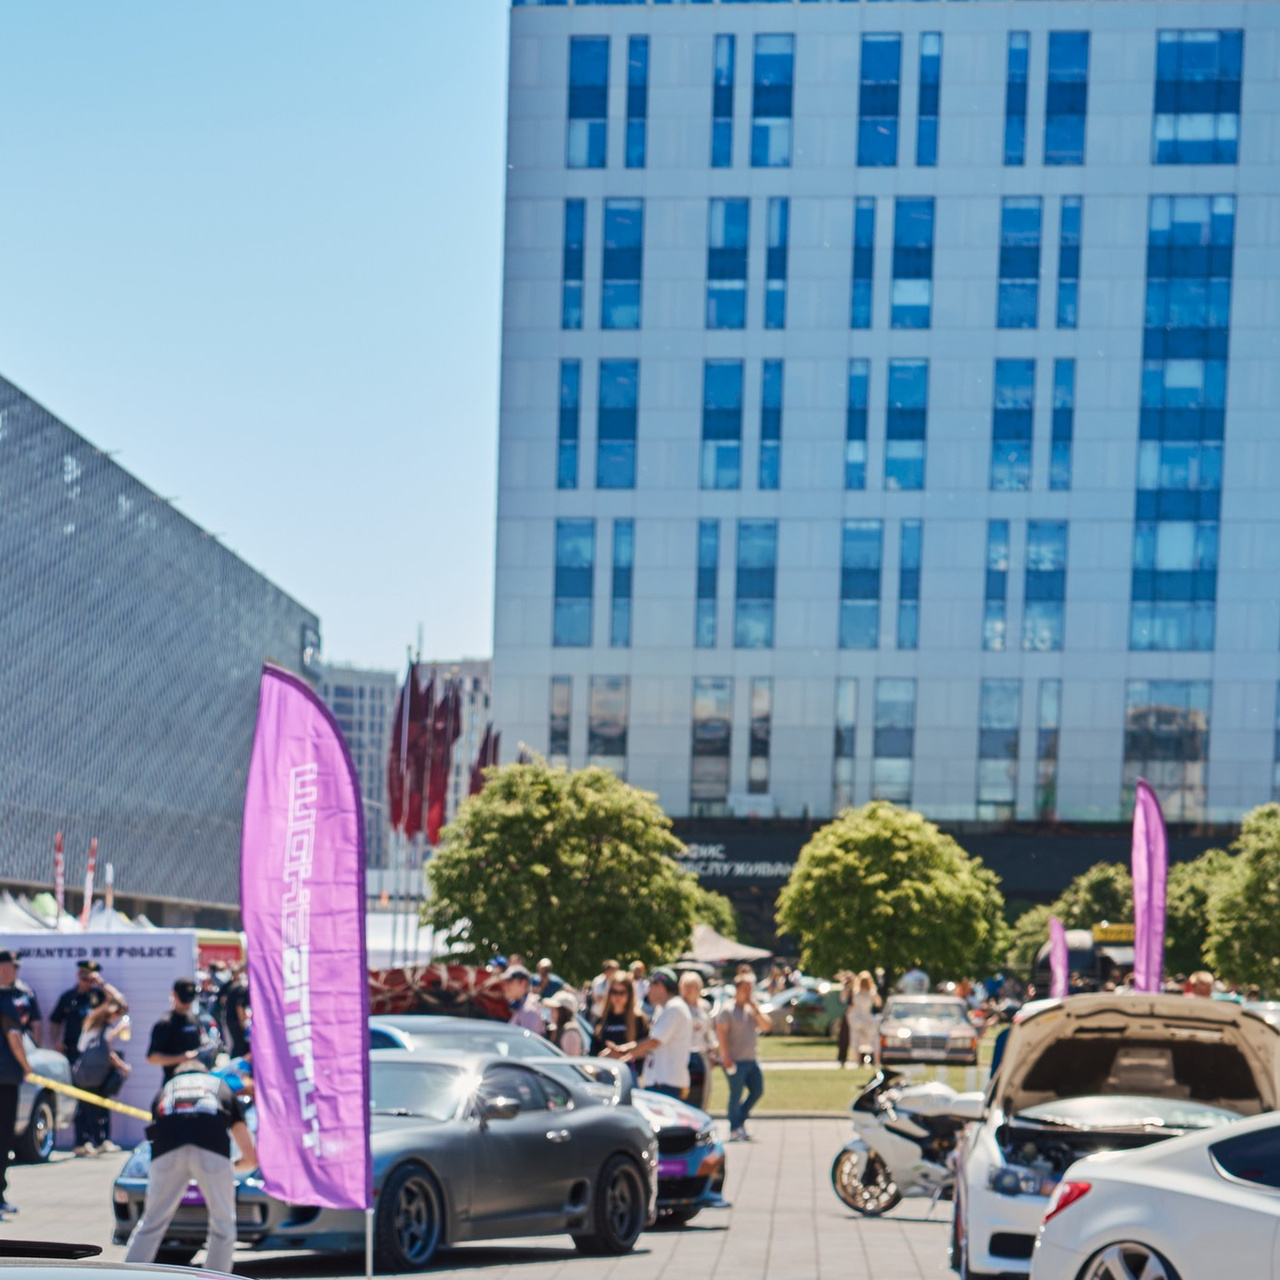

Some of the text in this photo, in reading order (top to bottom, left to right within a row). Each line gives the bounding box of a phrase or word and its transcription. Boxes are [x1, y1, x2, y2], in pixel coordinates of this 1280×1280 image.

[18, 945, 176, 959] WANTED BY POLICE
